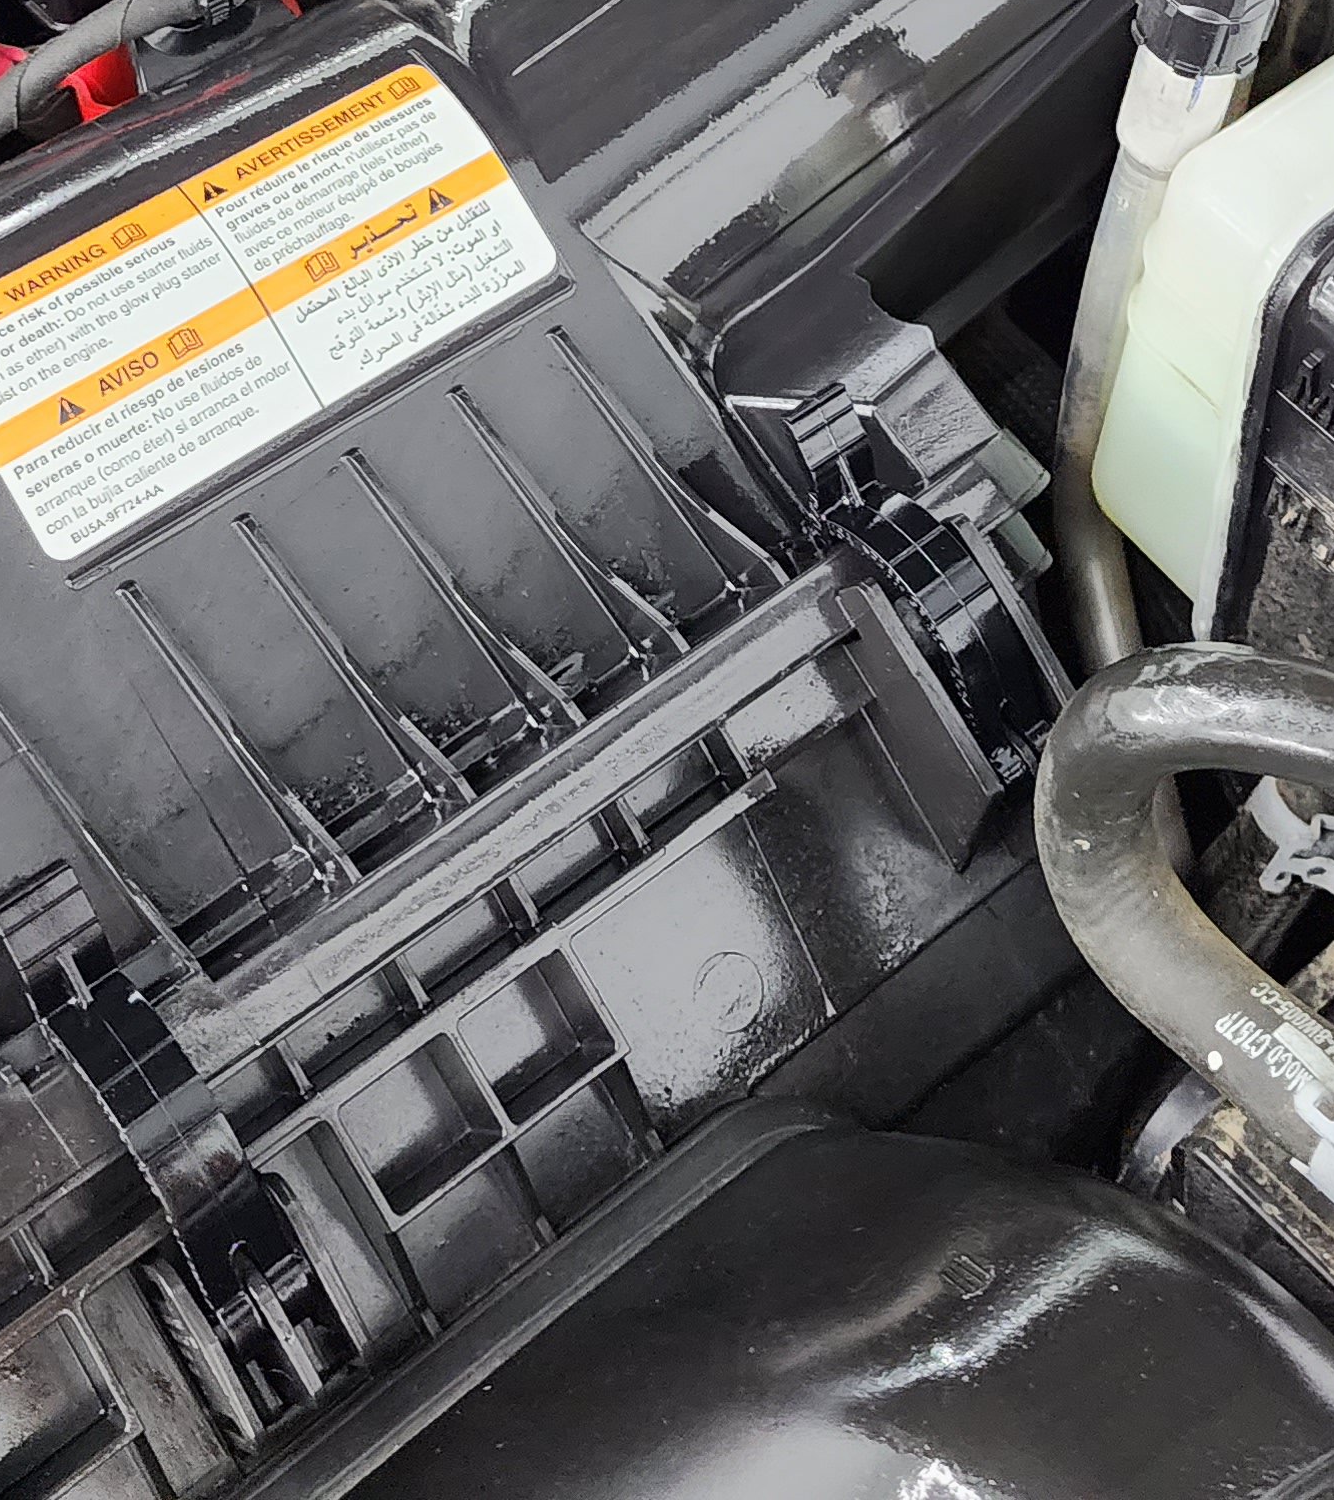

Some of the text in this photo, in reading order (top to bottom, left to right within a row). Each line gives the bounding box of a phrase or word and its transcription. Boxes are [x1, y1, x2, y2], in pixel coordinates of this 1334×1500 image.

[214, 98, 432, 218] Pour réduire le risque de blessures
[225, 111, 437, 233] graves ou de mort, n'utilisez pas de
[233, 131, 430, 244] fluides de démarrage (tels l'éther)
[236, 96, 386, 181] AVERTISSEMENT
[243, 142, 444, 258] avec ce moteur équipé de bougies
[253, 212, 355, 272] de préchauffage.
[0, 343, 16, 358] or
[18, 318, 65, 348] death:
[63, 306, 86, 323] Do
[86, 292, 111, 311] not
[109, 279, 136, 298] use
[136, 255, 177, 284] starter
[177, 237, 213, 261] fluids
[3, 244, 108, 302] WARNING
[5, 361, 25, 377] as
[25, 337, 67, 366] ether)
[66, 323, 97, 343] with
[94, 310, 119, 328] the
[119, 291, 150, 317] glow
[151, 275, 182, 300] plug
[180, 252, 222, 281] starter
[17, 307, 47, 328] risk
[47, 295, 64, 311] of
[64, 266, 124, 305] possible
[124, 237, 176, 269] serious
[13, 343, 245, 481] Para reducir el riesgo de lesiones
[18, 376, 38, 392] on
[37, 363, 62, 381] the
[62, 337, 114, 368] engine.
[98, 351, 159, 397] AVISO
[25, 355, 263, 498] severas o muerte: No use fluidos de
[35, 360, 291, 517] arranque (como éter) si arranca el motor
[45, 406, 260, 535] con la bujía caliente de arranque.
[69, 484, 165, 544] BU5A-9F724-AA
[1266, 1046, 1313, 1091] MoCo
